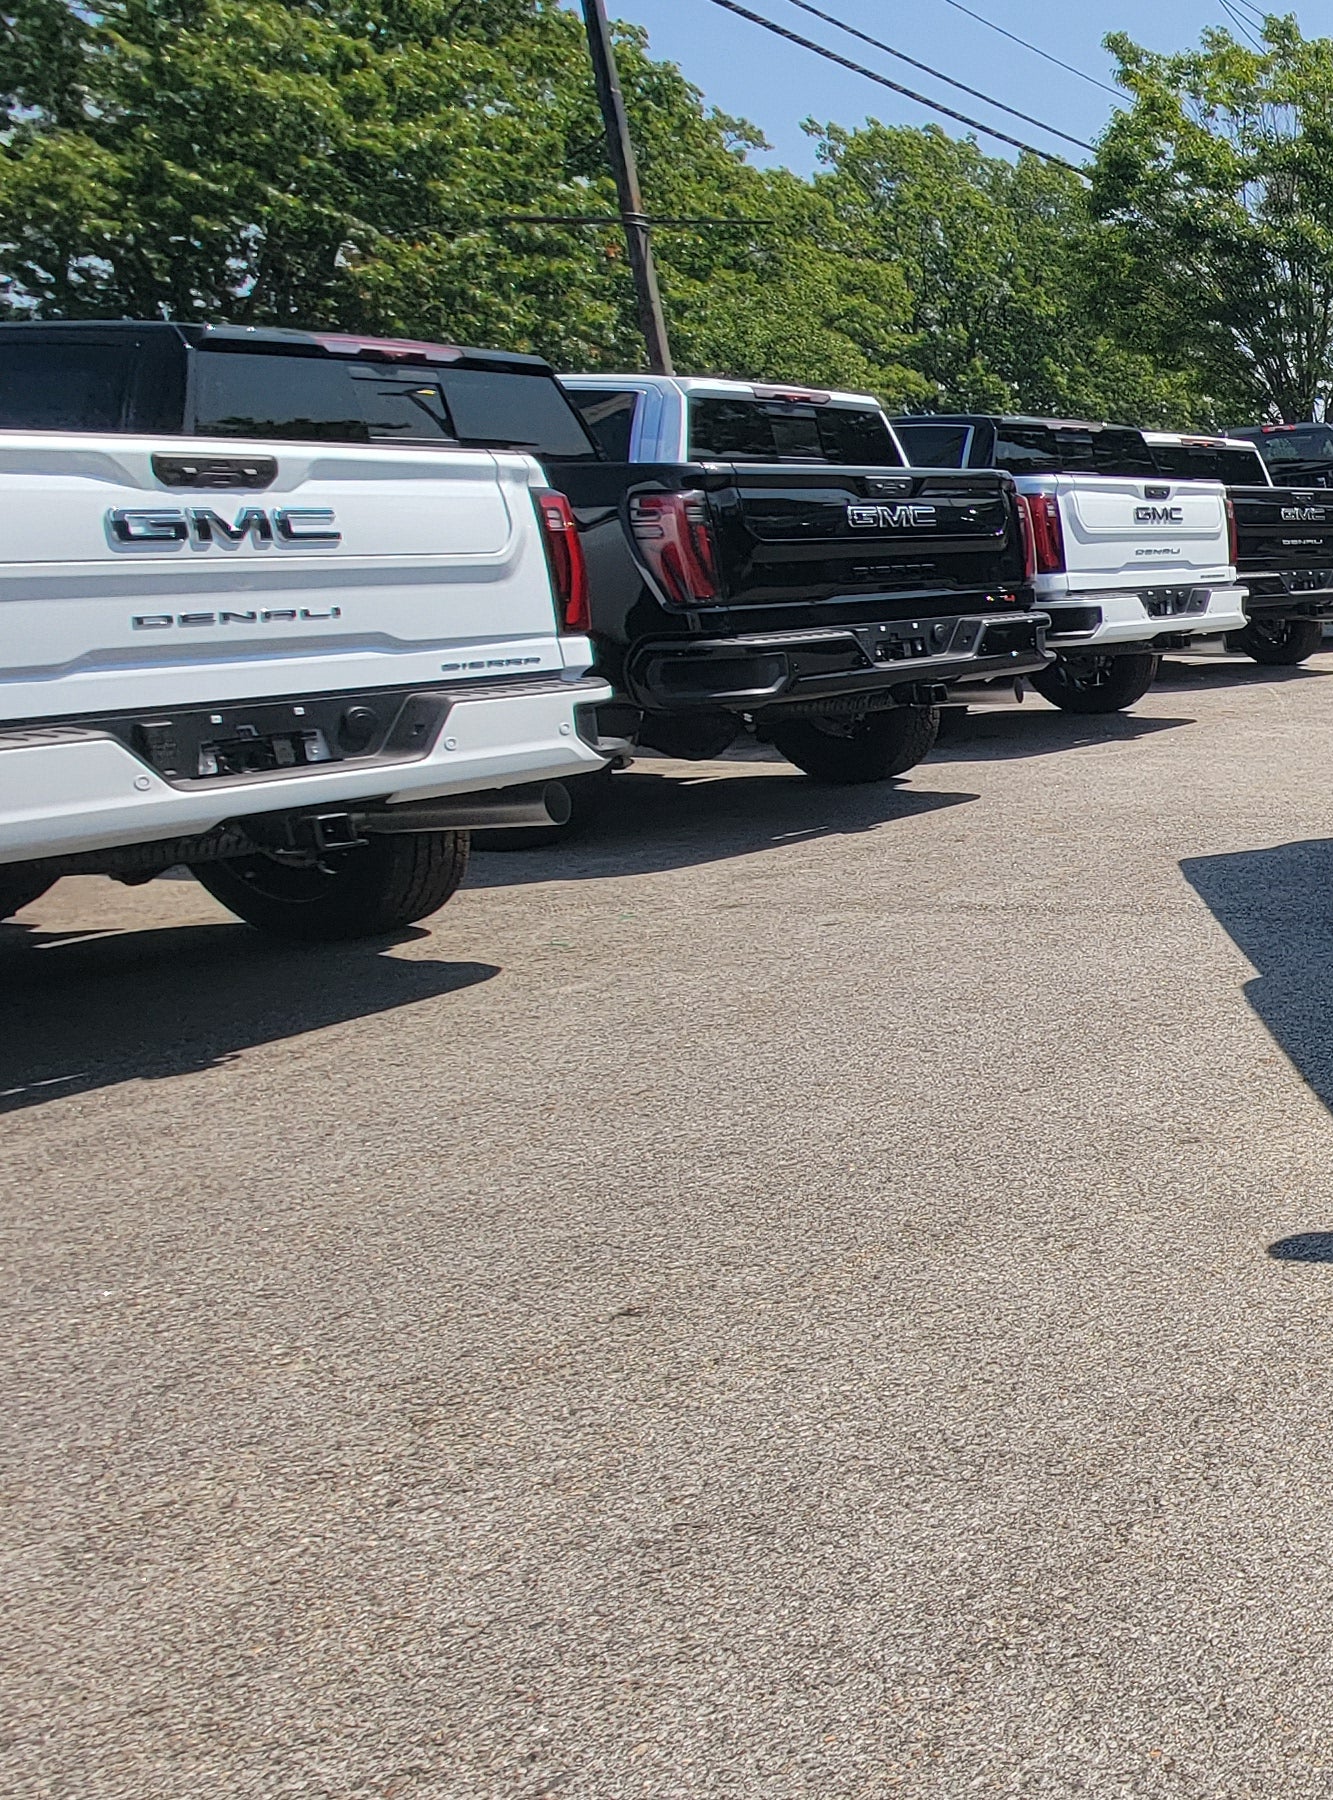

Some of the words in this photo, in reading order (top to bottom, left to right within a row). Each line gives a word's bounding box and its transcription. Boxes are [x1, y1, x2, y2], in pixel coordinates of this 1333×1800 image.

[847, 505, 937, 528] GMC
[1133, 506, 1184, 525] GMC
[1281, 507, 1326, 521] GMC
[104, 506, 343, 553] GMC
[1135, 548, 1180, 556] DENALI
[132, 606, 342, 631] DENALI
